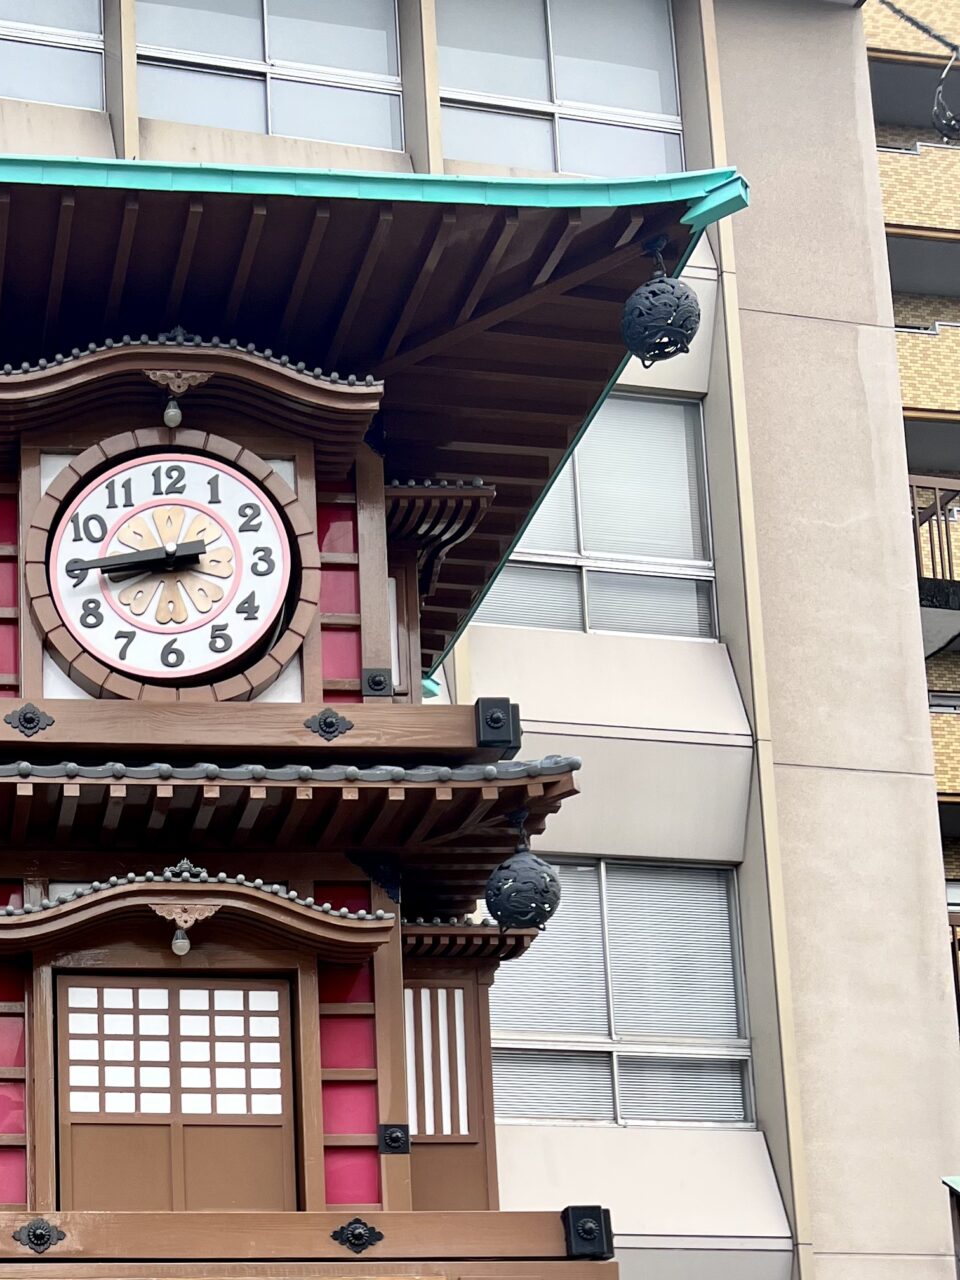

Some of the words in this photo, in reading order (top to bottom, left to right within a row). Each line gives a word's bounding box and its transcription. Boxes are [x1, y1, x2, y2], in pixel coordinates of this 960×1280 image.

[106, 478, 134, 508] 11
[152, 465, 186, 495] 12
[207, 474, 222, 504] 1
[71, 512, 107, 543] 10
[238, 503, 262, 532] 2
[66, 558, 88, 587] 9
[251, 547, 275, 576] 3
[80, 599, 104, 628] 8
[236, 591, 260, 620] 4
[114, 631, 136, 660] 7
[161, 638, 185, 667] 6
[209, 624, 233, 652] 5
